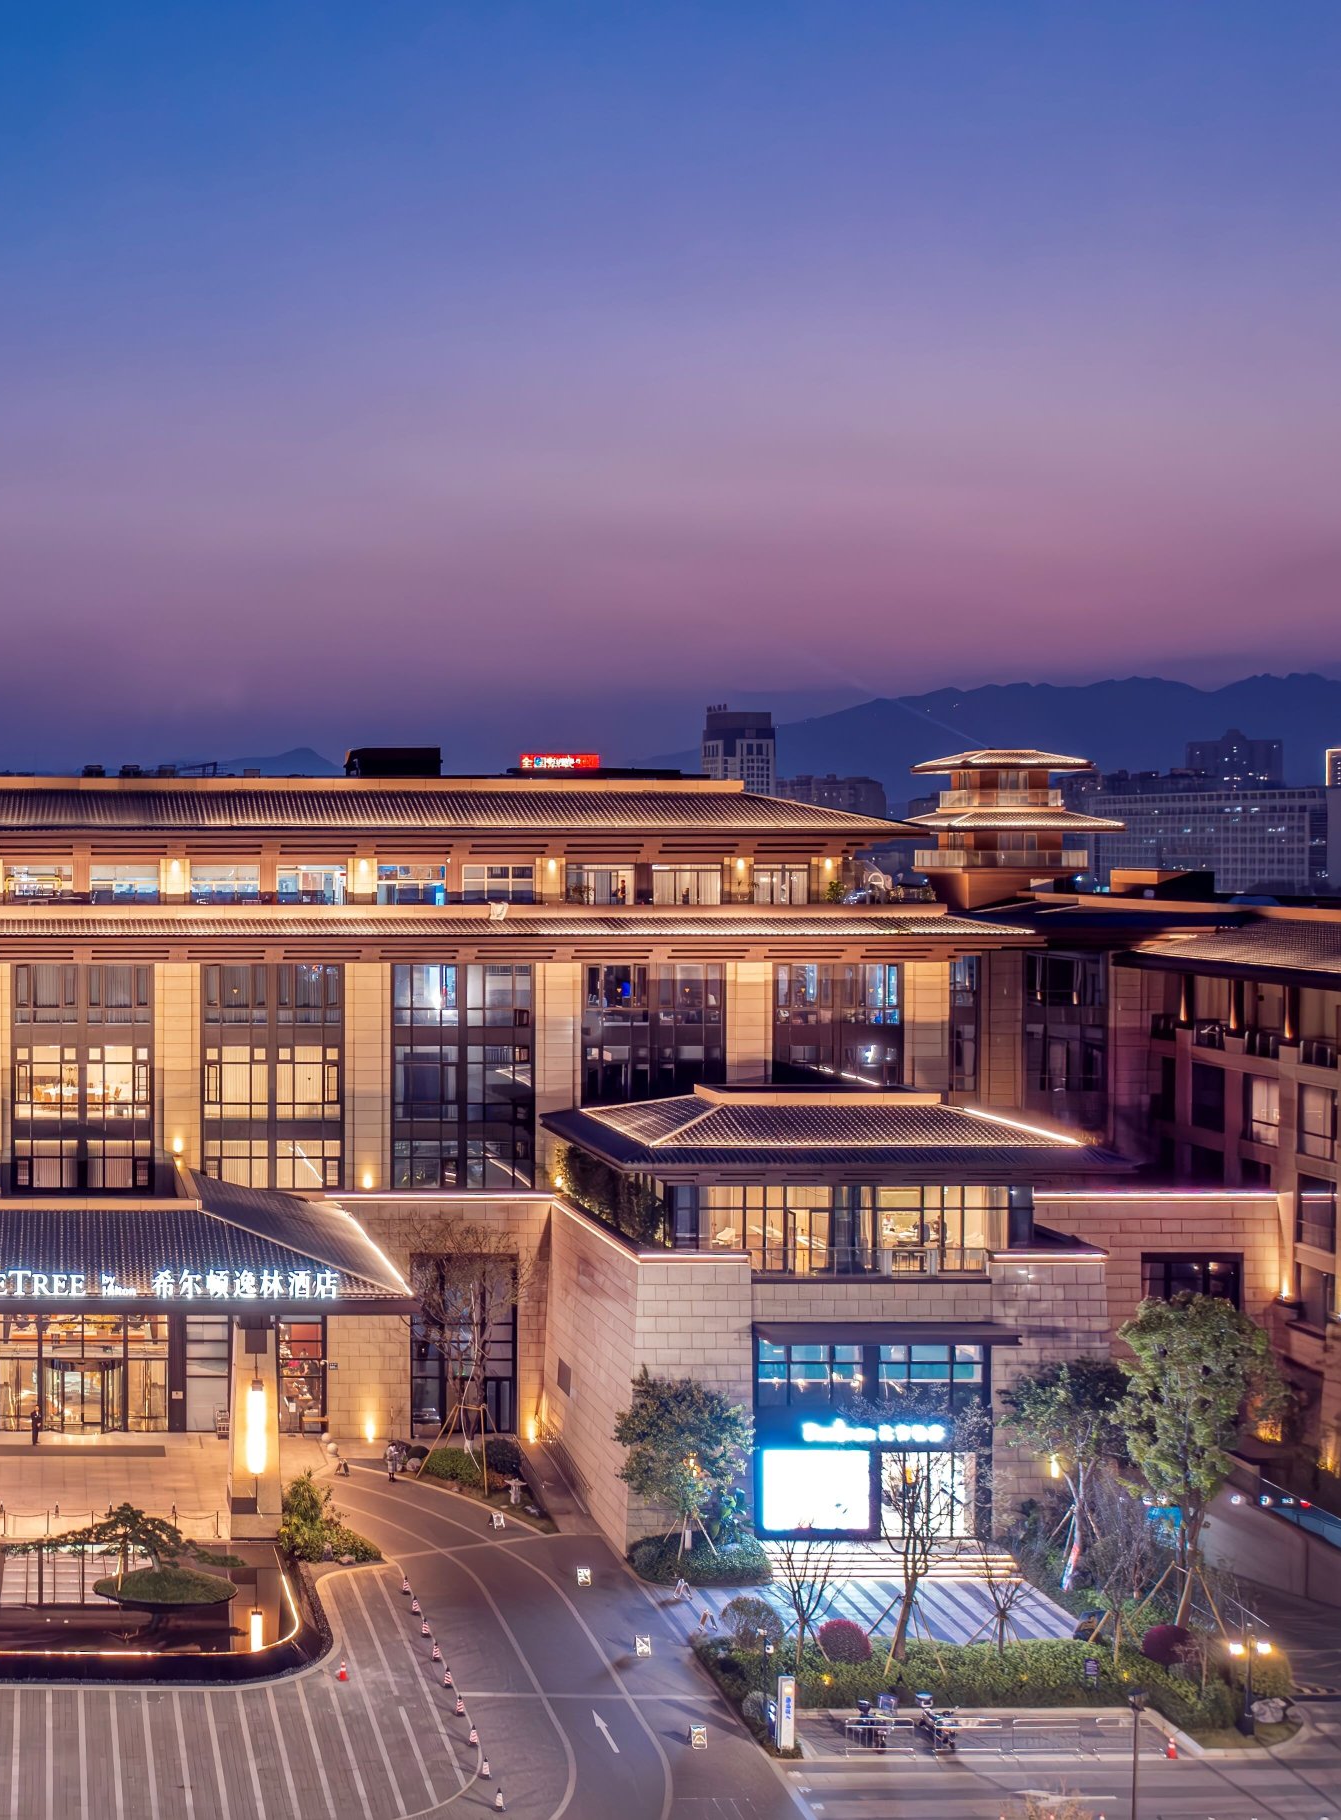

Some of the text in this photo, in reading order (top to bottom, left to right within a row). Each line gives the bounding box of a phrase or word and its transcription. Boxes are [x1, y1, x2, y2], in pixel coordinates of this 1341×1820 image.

[152, 1269, 340, 1299] 希尔顿逸林酒店
